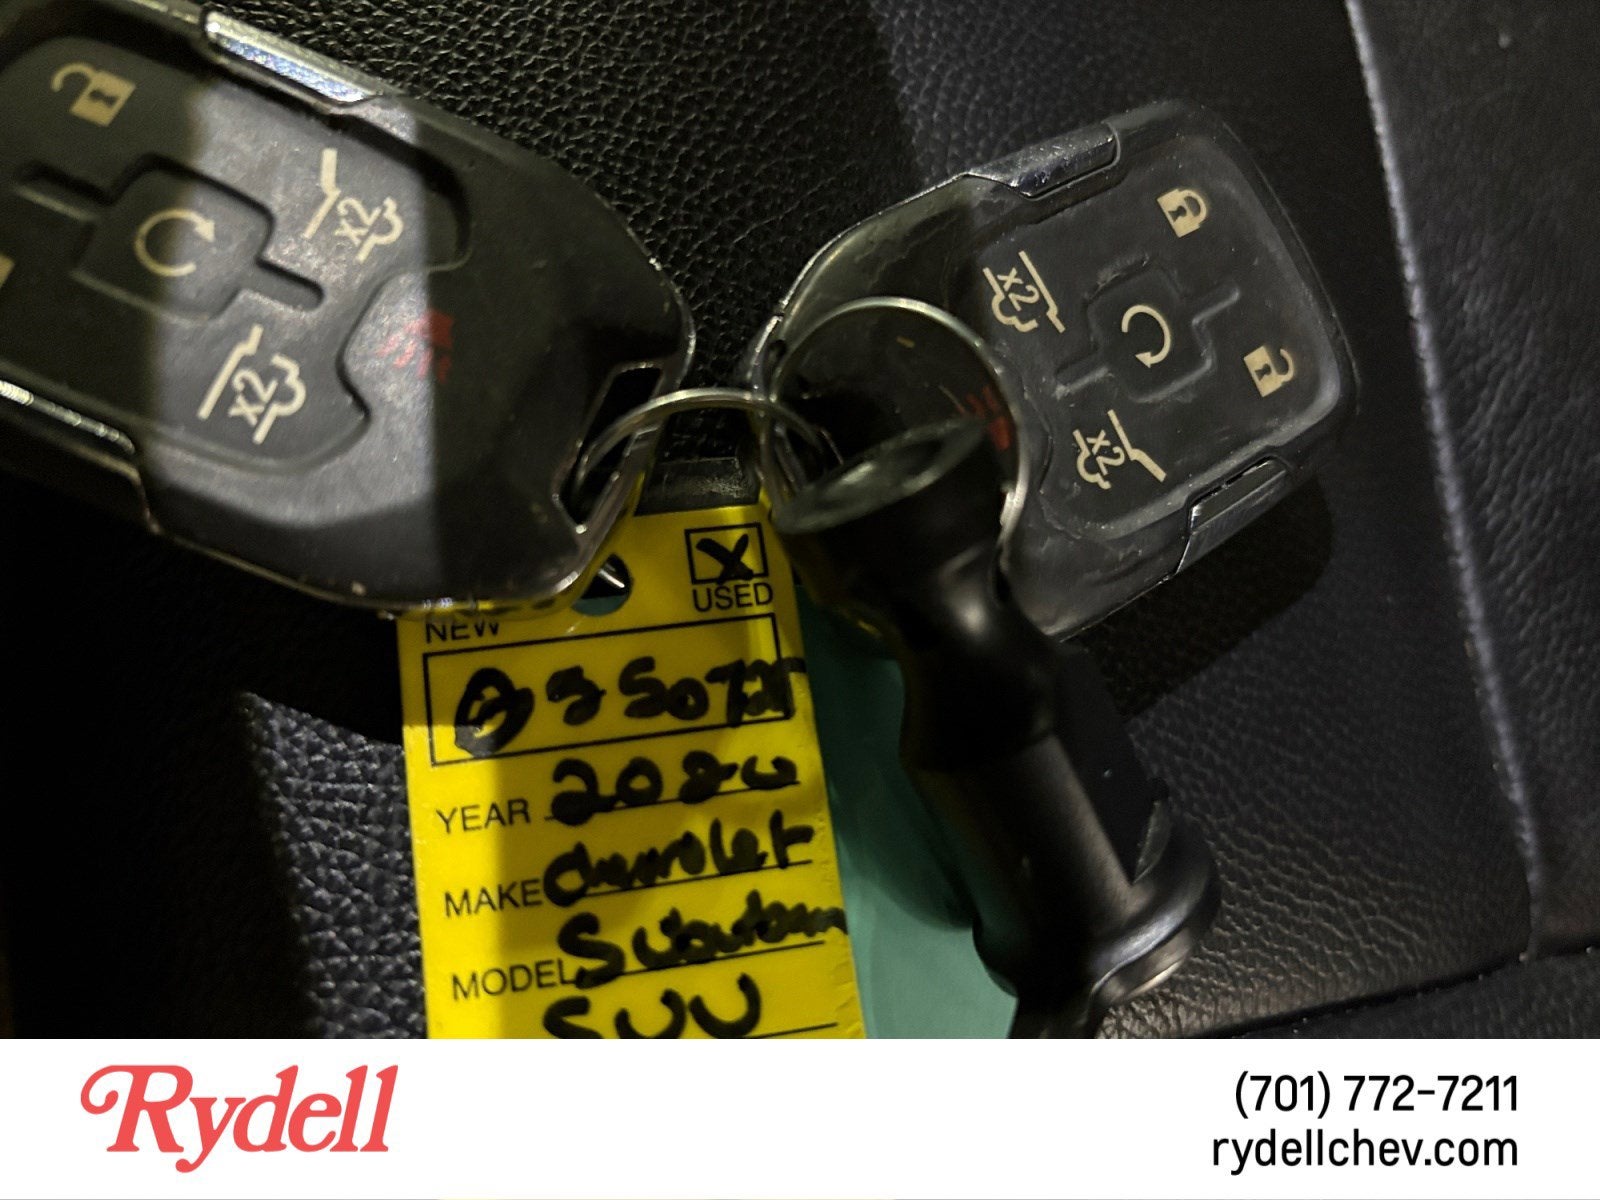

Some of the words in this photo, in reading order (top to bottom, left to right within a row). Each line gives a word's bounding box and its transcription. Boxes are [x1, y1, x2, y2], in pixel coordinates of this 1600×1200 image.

[333, 197, 381, 245] x2
[997, 267, 1040, 312] x2
[227, 369, 279, 426] x2
[1086, 429, 1126, 476] x2
[692, 581, 774, 613] USED
[425, 621, 500, 644] NEW
[436, 798, 531, 834] YEAR
[444, 878, 543, 918] MAKE
[452, 958, 577, 1001] MODEL
